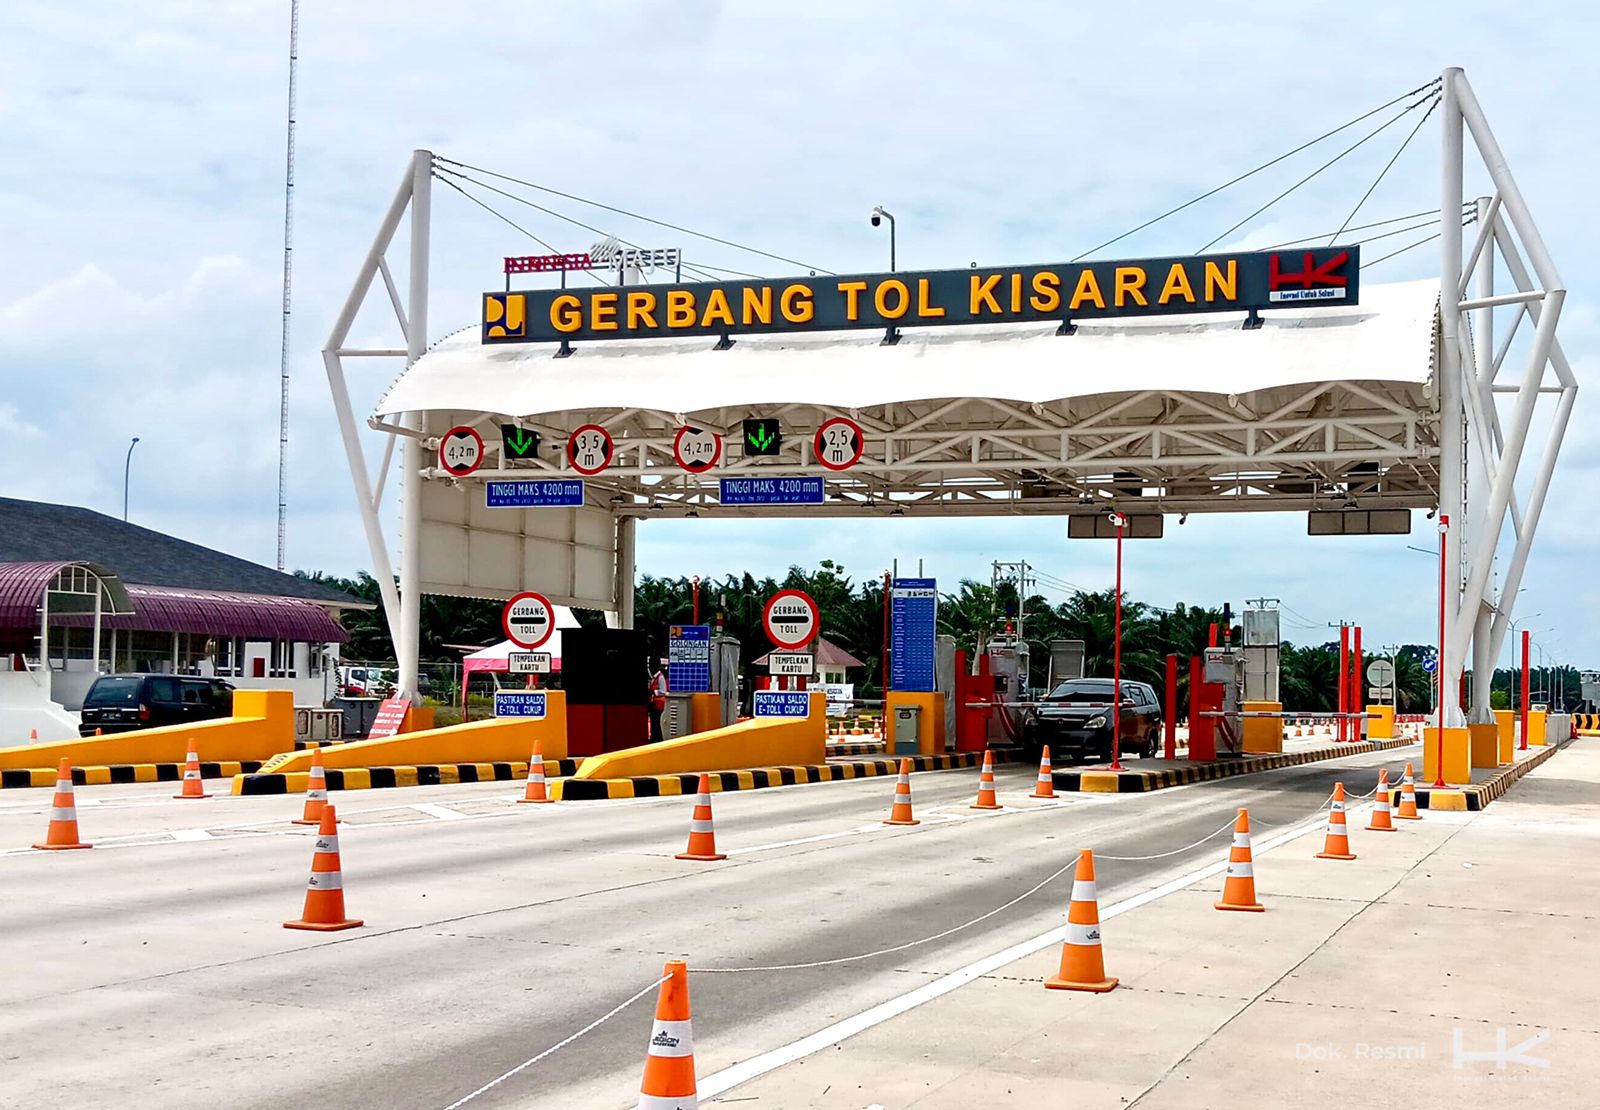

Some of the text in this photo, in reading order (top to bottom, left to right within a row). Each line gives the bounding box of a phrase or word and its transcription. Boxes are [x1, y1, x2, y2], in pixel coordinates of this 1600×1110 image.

[1269, 250, 1349, 290] HK
[549, 259, 1239, 333] GERBANG TOL KISARAN
[581, 435, 599, 452] 3,5
[829, 430, 848, 448] 2,5
[449, 446, 474, 459] 4,2 m
[684, 442, 712, 455] 4,2 m
[584, 454, 594, 465] m
[832, 449, 843, 462] m
[491, 483, 580, 496] TINGGI MAKS 4200 mm
[725, 480, 818, 493] TINGGI MAKS 4200 mm
[512, 607, 545, 616] GERBANG
[773, 606, 807, 614] GERBANG
[520, 626, 536, 634] TOLL
[780, 625, 798, 633] TOLL
[671, 640, 707, 648] GOLONGAN
[513, 655, 546, 663] TEMPELKAN
[775, 656, 809, 664] TEMPELKAN
[520, 663, 540, 671] KARTU
[781, 665, 802, 673] KARTU
[497, 695, 544, 705] PASTIKAN SALDO
[756, 694, 807, 704] PASTIKAN SALDO
[499, 705, 542, 714] E-TOLL CUKUP
[758, 705, 805, 714] E-TOLL CUKUP
